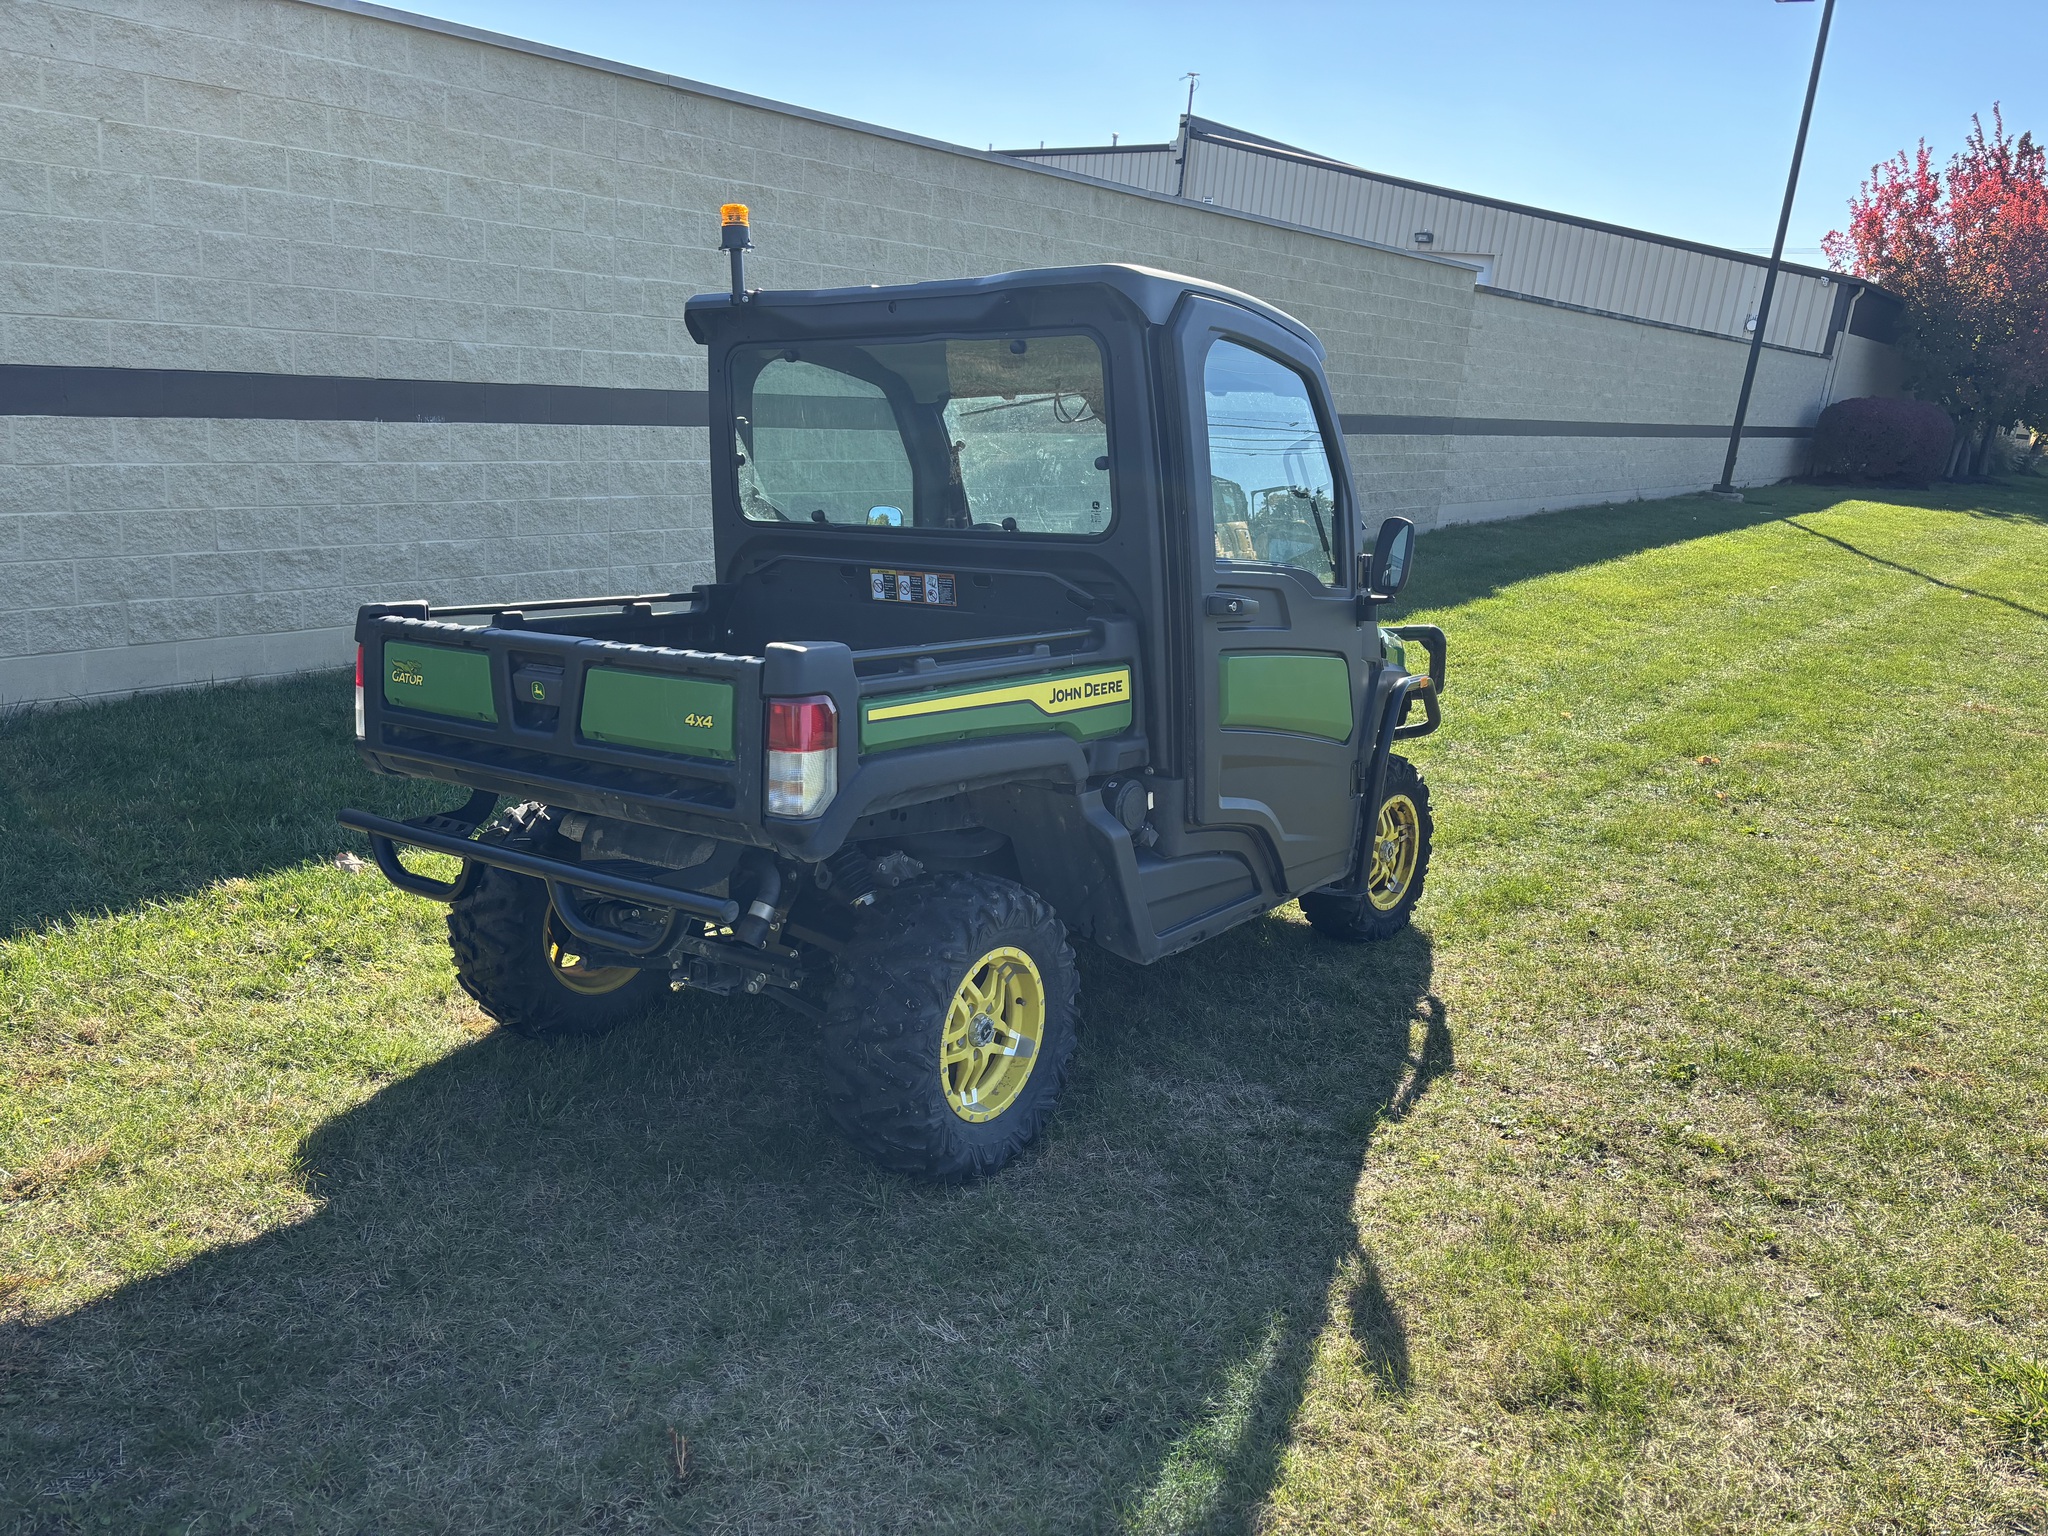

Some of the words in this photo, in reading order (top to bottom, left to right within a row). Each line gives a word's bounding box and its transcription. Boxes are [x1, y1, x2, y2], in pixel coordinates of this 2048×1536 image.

[391, 670, 423, 686] GATOR
[1049, 686, 1082, 704] JOHN
[1084, 679, 1123, 698] DEERE
